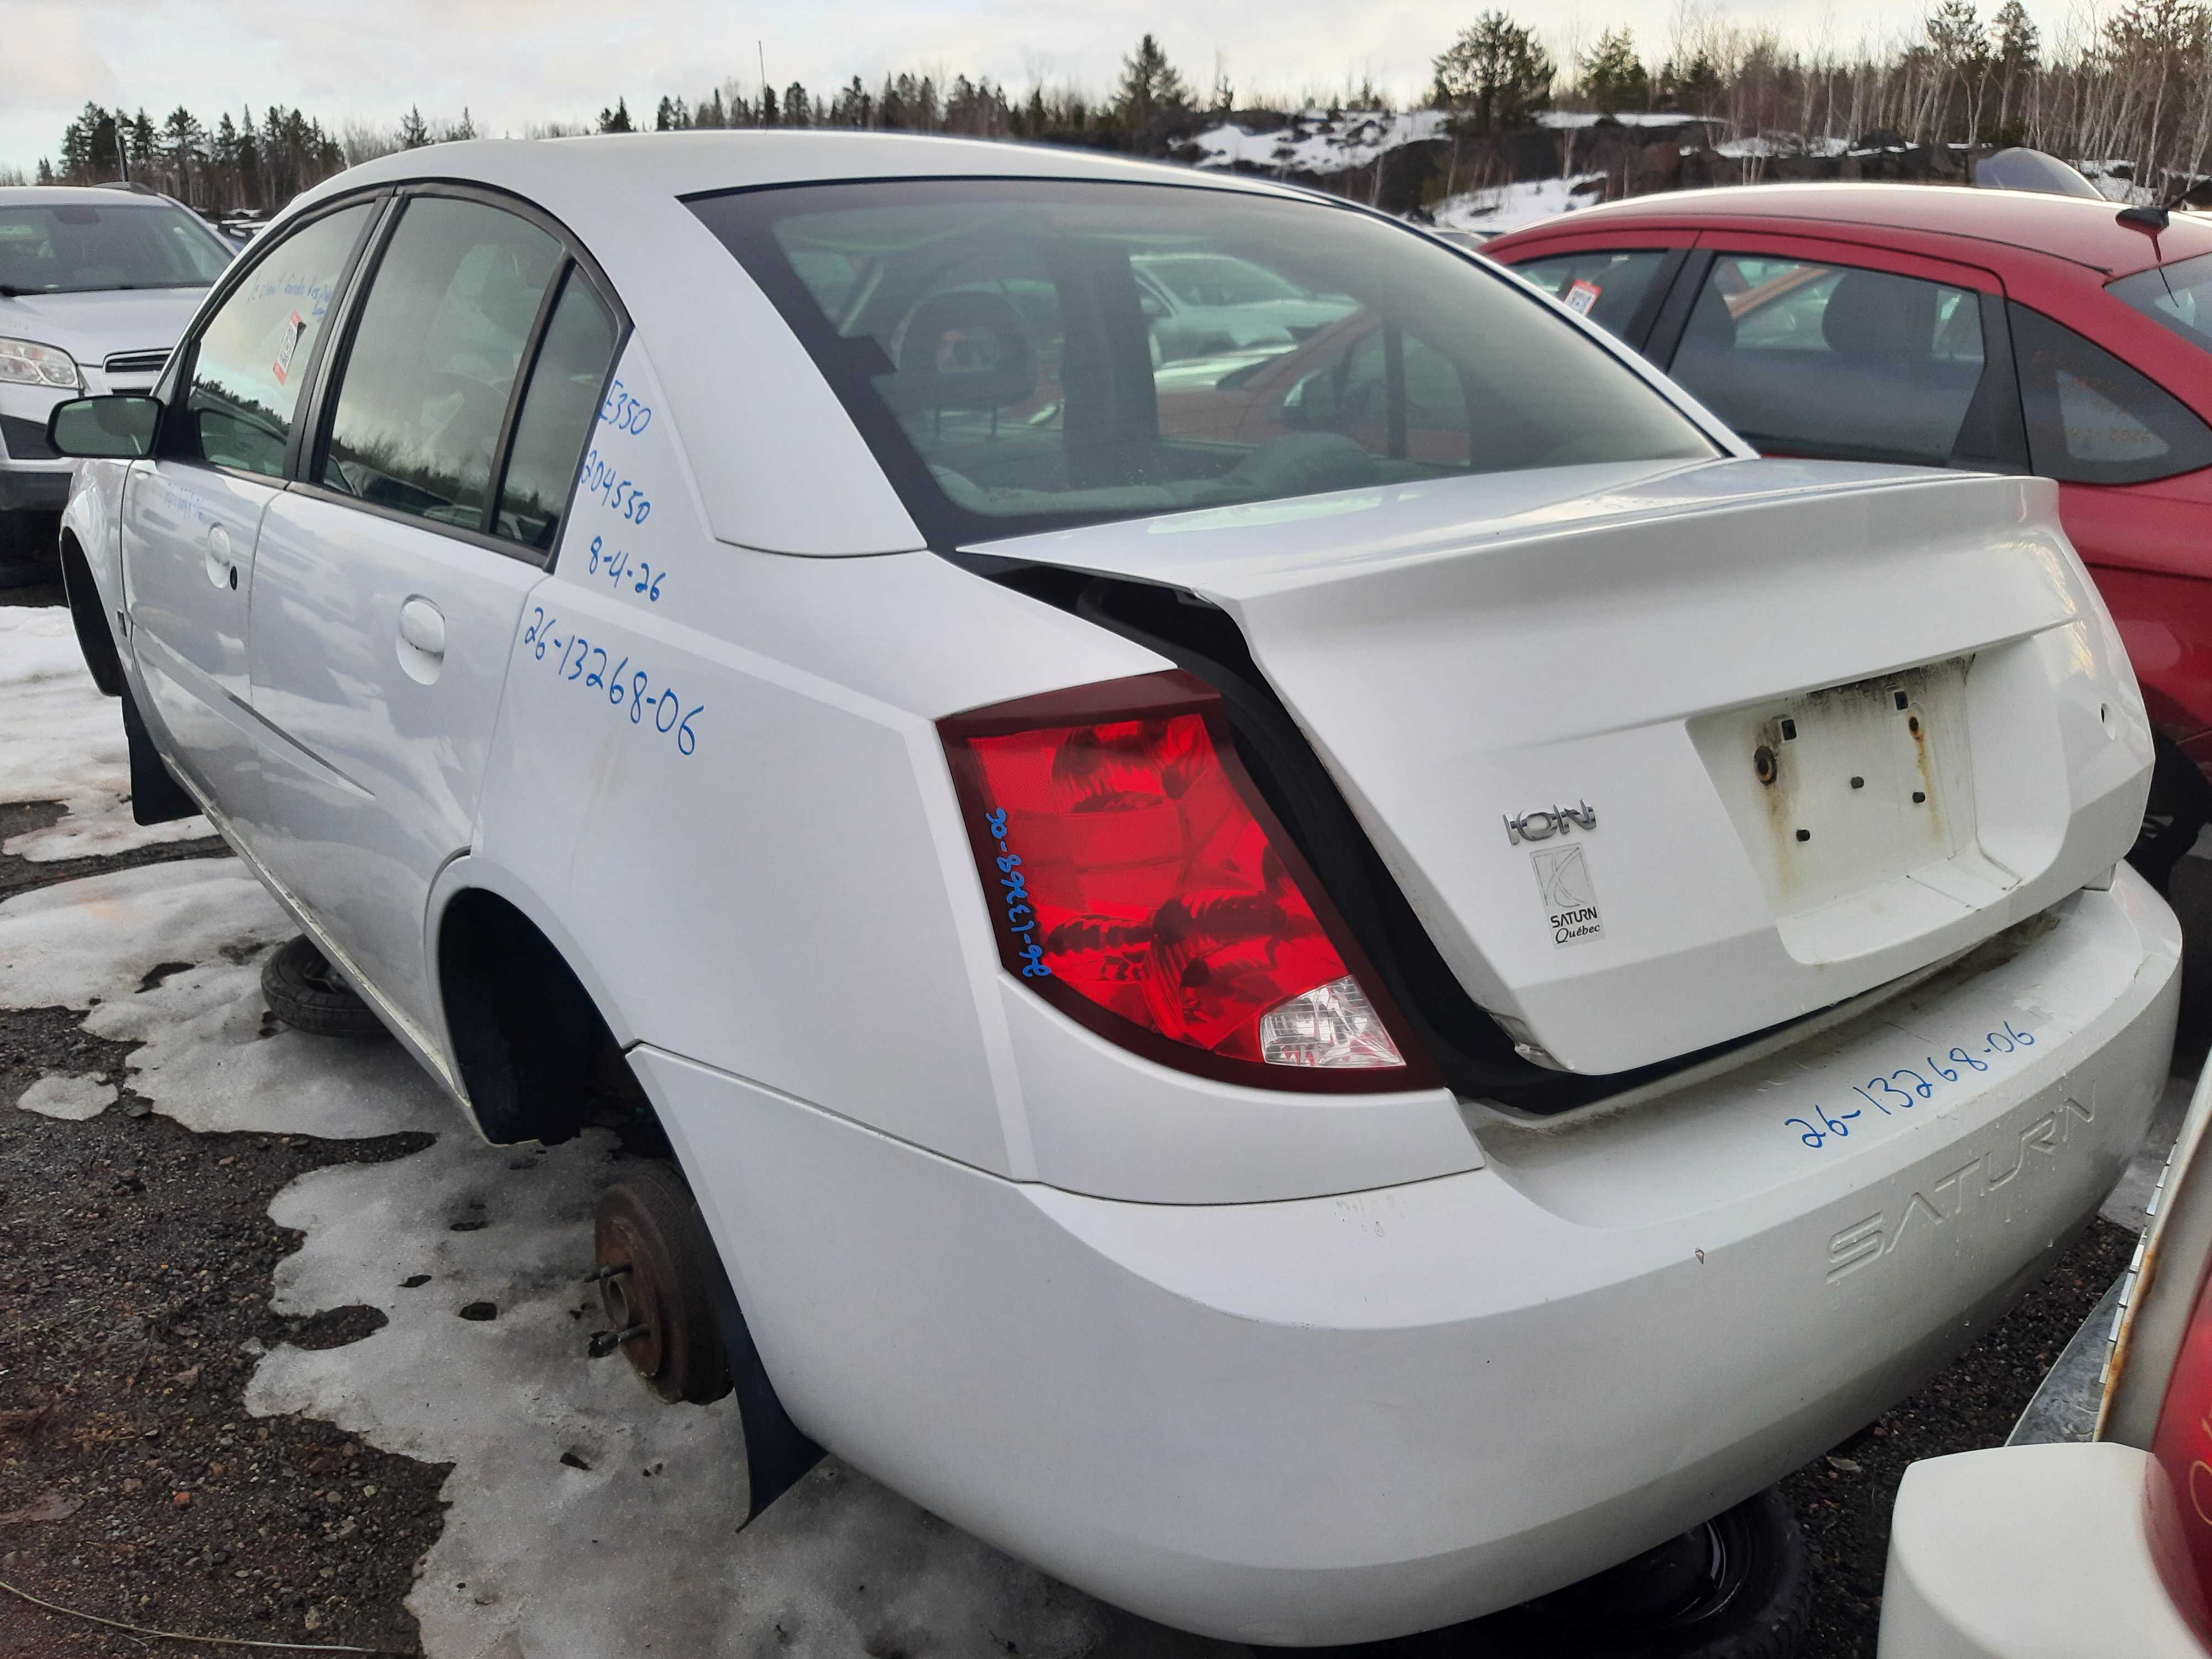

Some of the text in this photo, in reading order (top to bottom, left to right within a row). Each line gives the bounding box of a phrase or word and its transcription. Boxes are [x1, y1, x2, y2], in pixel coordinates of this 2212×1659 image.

[599, 379, 652, 435] E350
[588, 535, 666, 602] 8-4-26
[524, 607, 705, 755] 26-13268-06
[1502, 798, 1597, 846] ION
[1550, 906, 1598, 928] SATURN
[1554, 924, 1600, 945] Québec
[1783, 1020, 2036, 1149] 26-13268-06
[1825, 1078, 2098, 1284] SATURN
